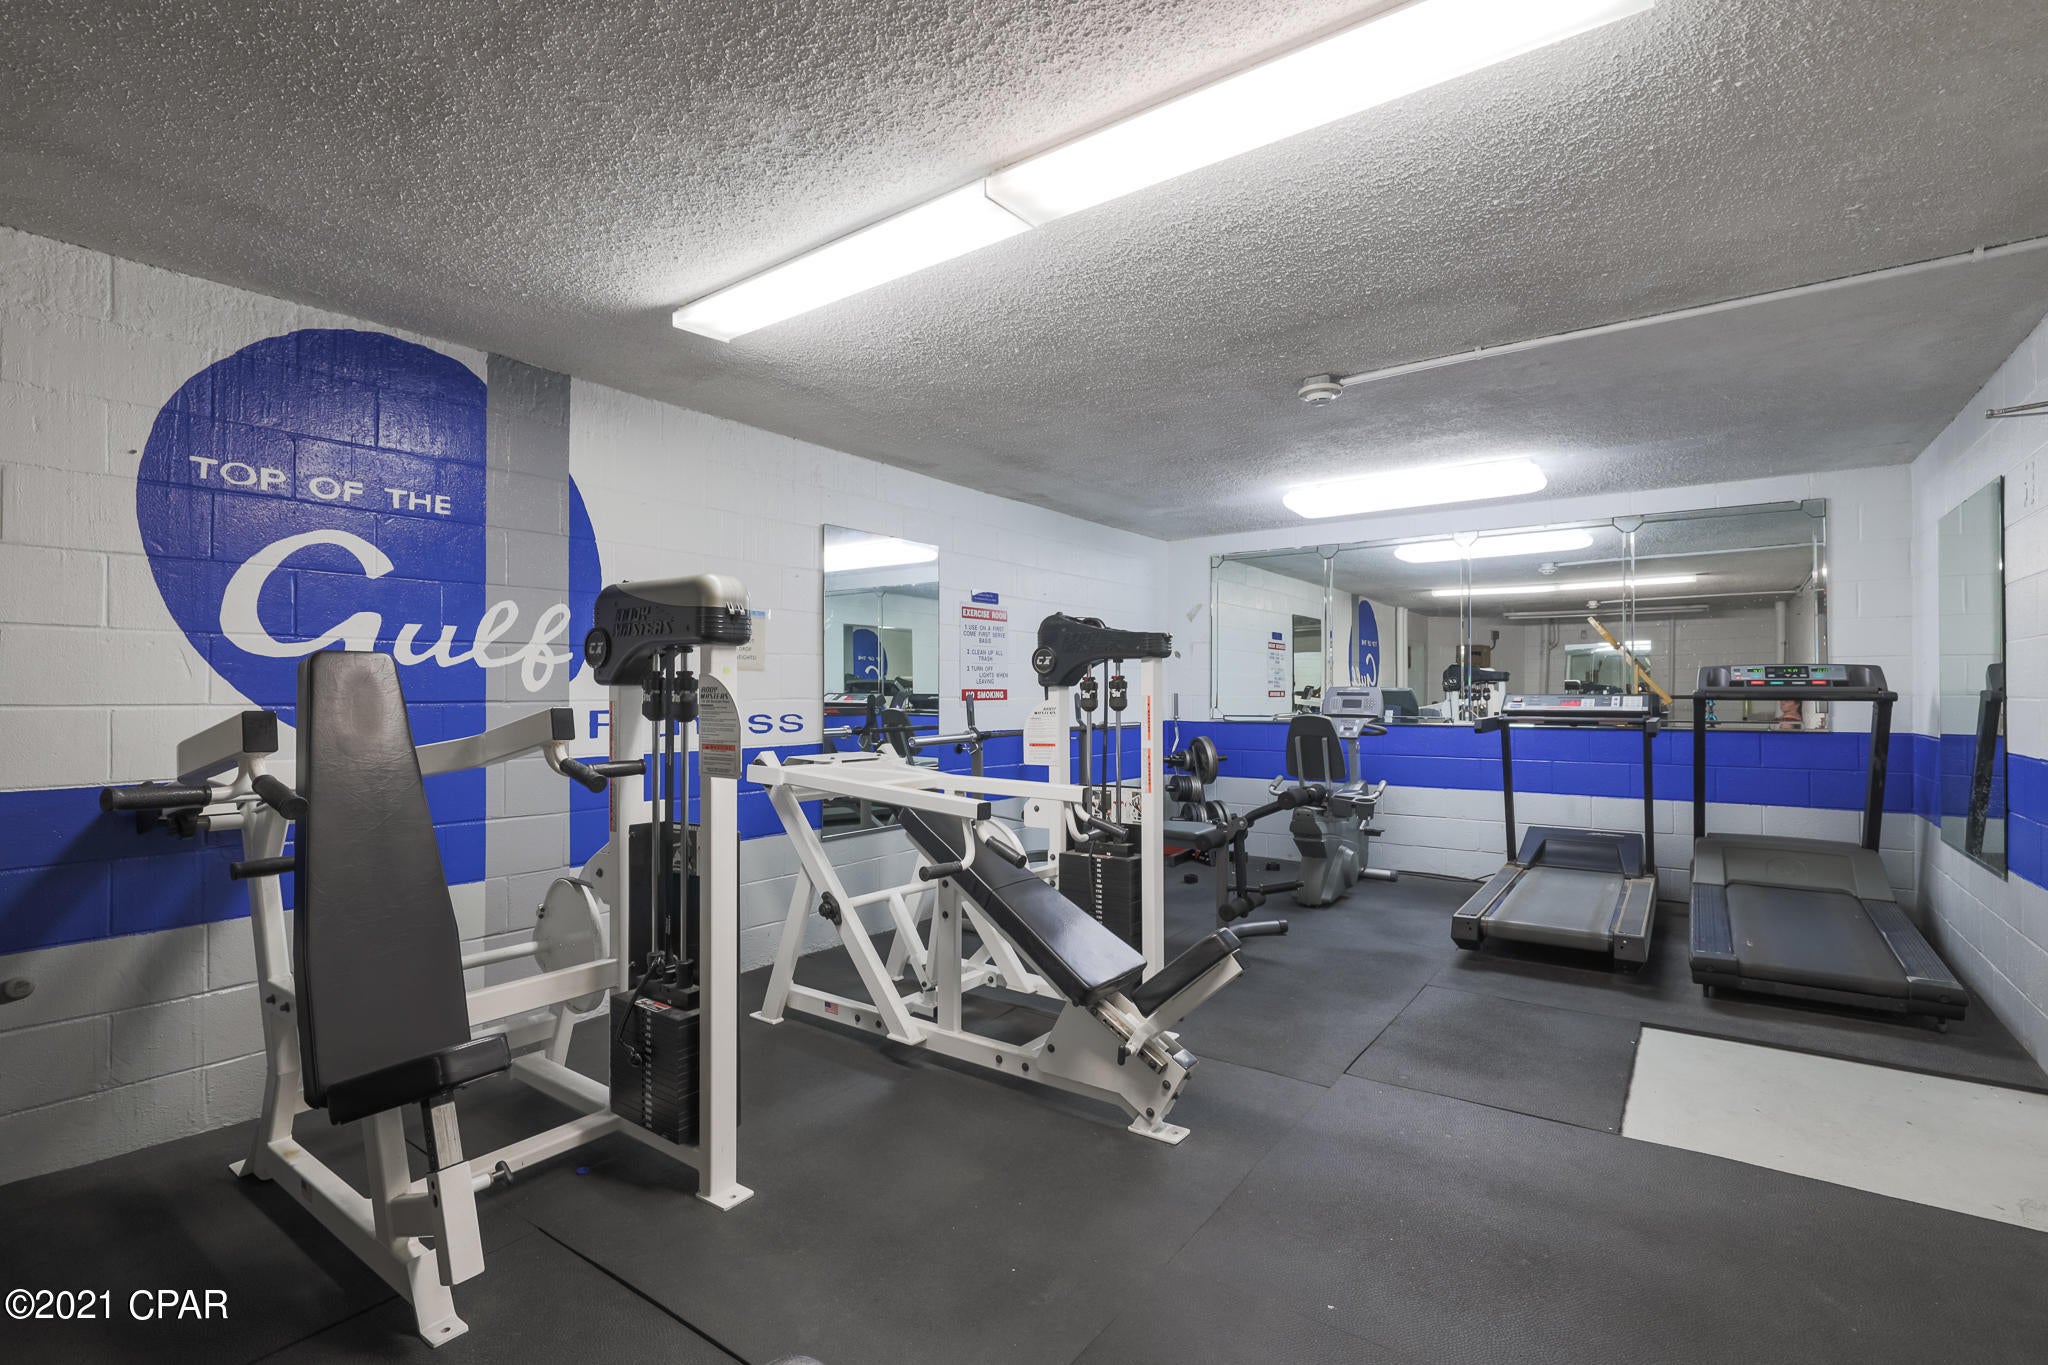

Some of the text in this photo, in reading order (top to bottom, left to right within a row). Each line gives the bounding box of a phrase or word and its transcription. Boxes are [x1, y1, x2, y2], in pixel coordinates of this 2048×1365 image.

[189, 455, 451, 515] TOP OF THE
[219, 529, 574, 692] Gulf
[962, 608, 990, 618] EXERCISE
[977, 690, 1004, 699] SMOKING
